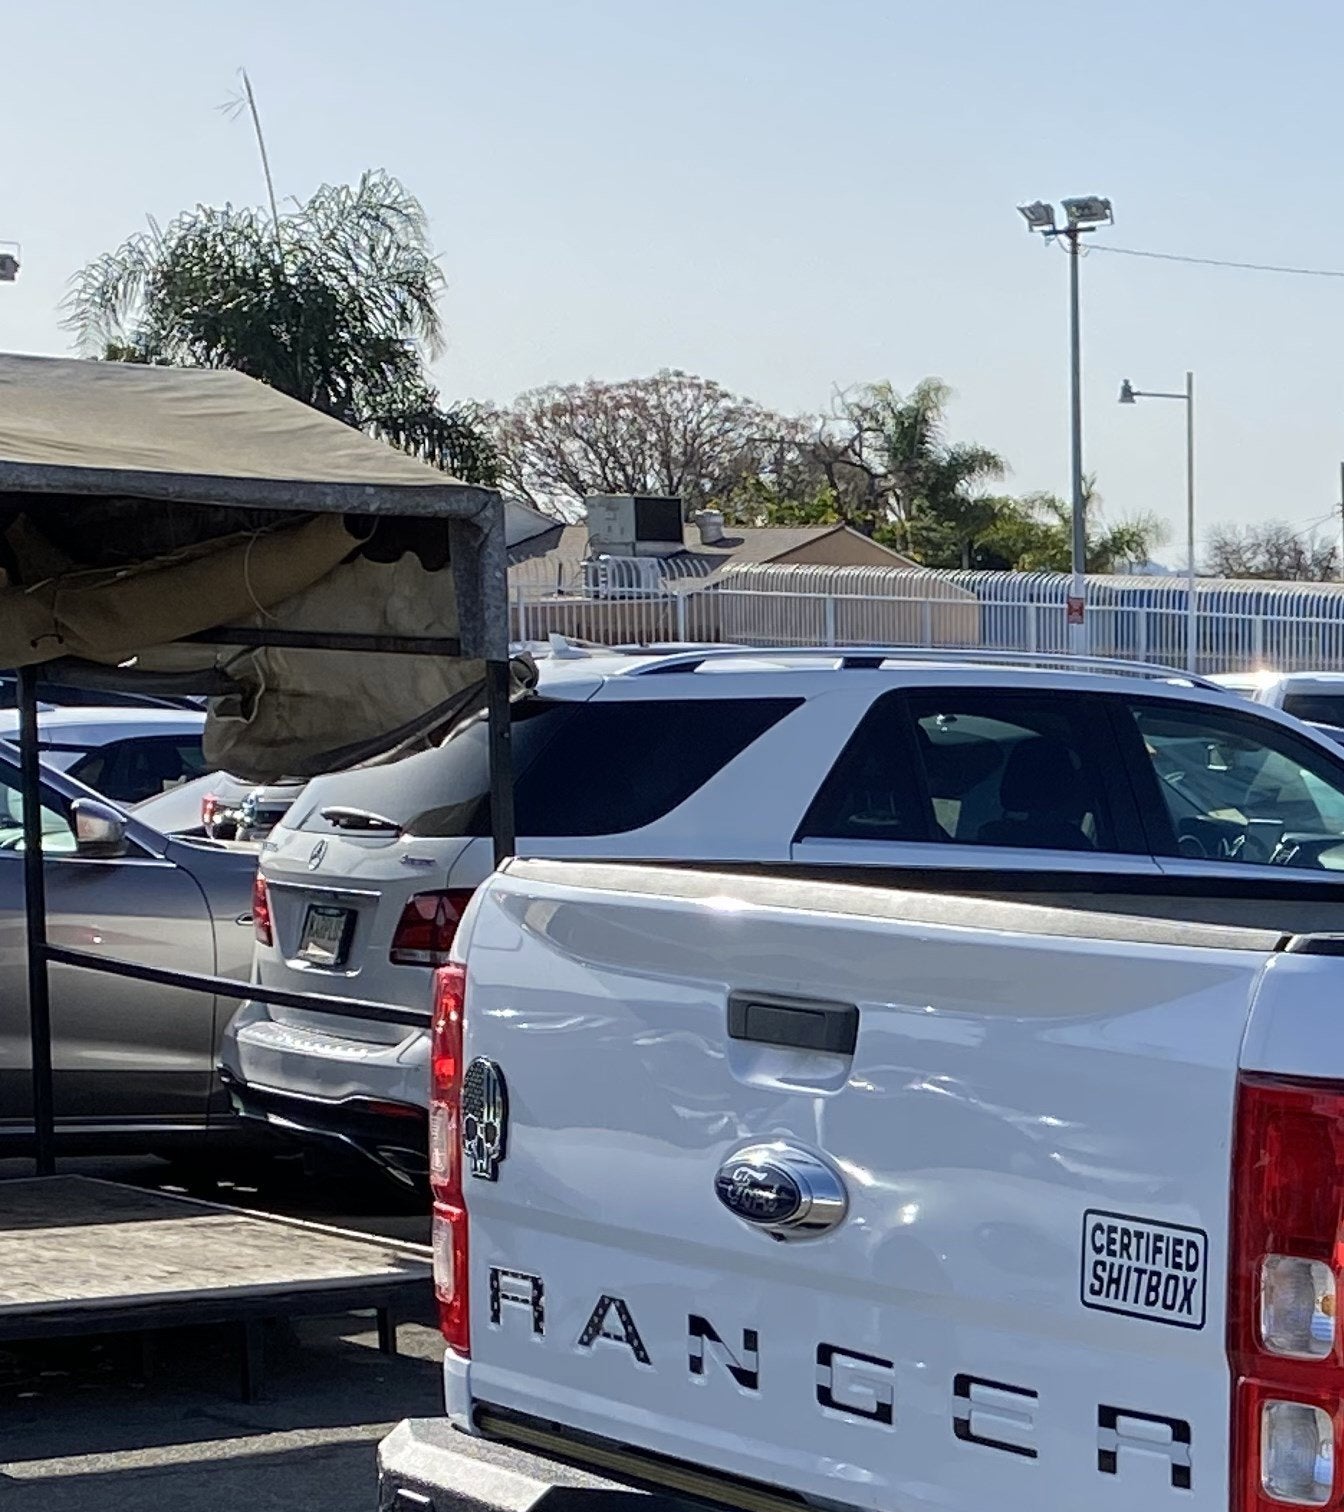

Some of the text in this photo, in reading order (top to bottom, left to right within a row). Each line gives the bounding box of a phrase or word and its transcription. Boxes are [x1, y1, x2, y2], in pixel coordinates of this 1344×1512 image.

[1091, 1222, 1199, 1272] CERTIFIED
[1089, 1259, 1197, 1315] SHITBOX
[488, 1266, 1193, 1489] RANGER
